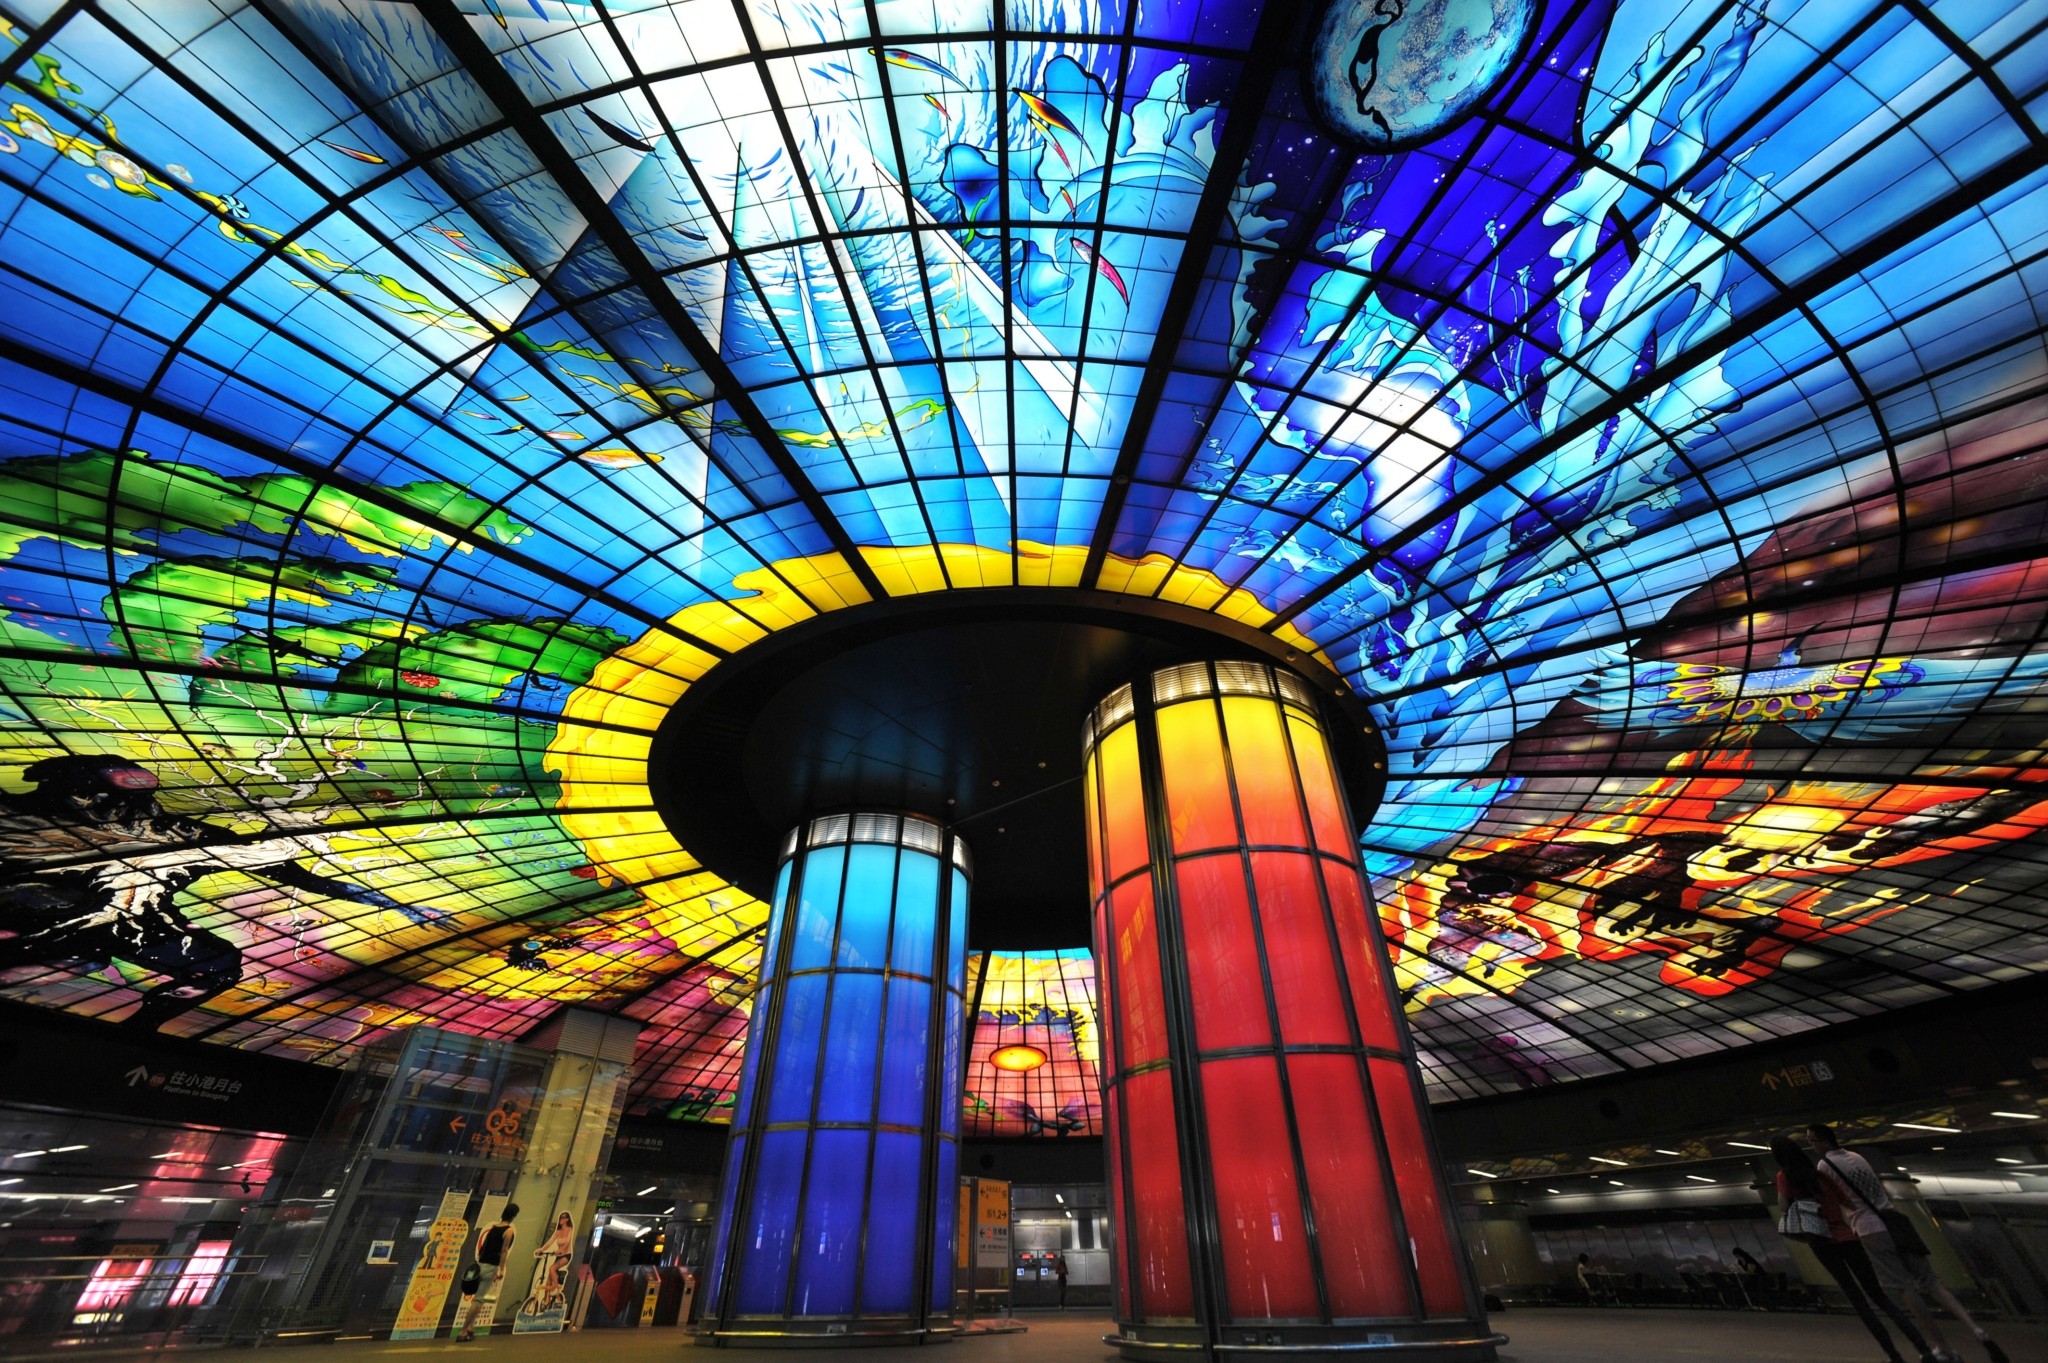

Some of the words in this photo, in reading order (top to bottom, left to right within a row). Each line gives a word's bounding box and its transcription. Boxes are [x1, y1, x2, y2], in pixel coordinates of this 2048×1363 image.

[1780, 1067, 1795, 1087] 1
[1787, 1064, 1811, 1079] 出口
[169, 1070, 243, 1094] 往小港月台
[1794, 1077, 1814, 1087] EXIT
[163, 1085, 191, 1096] Platform
[191, 1089, 200, 1097] to
[437, 1273, 453, 1281] 165
